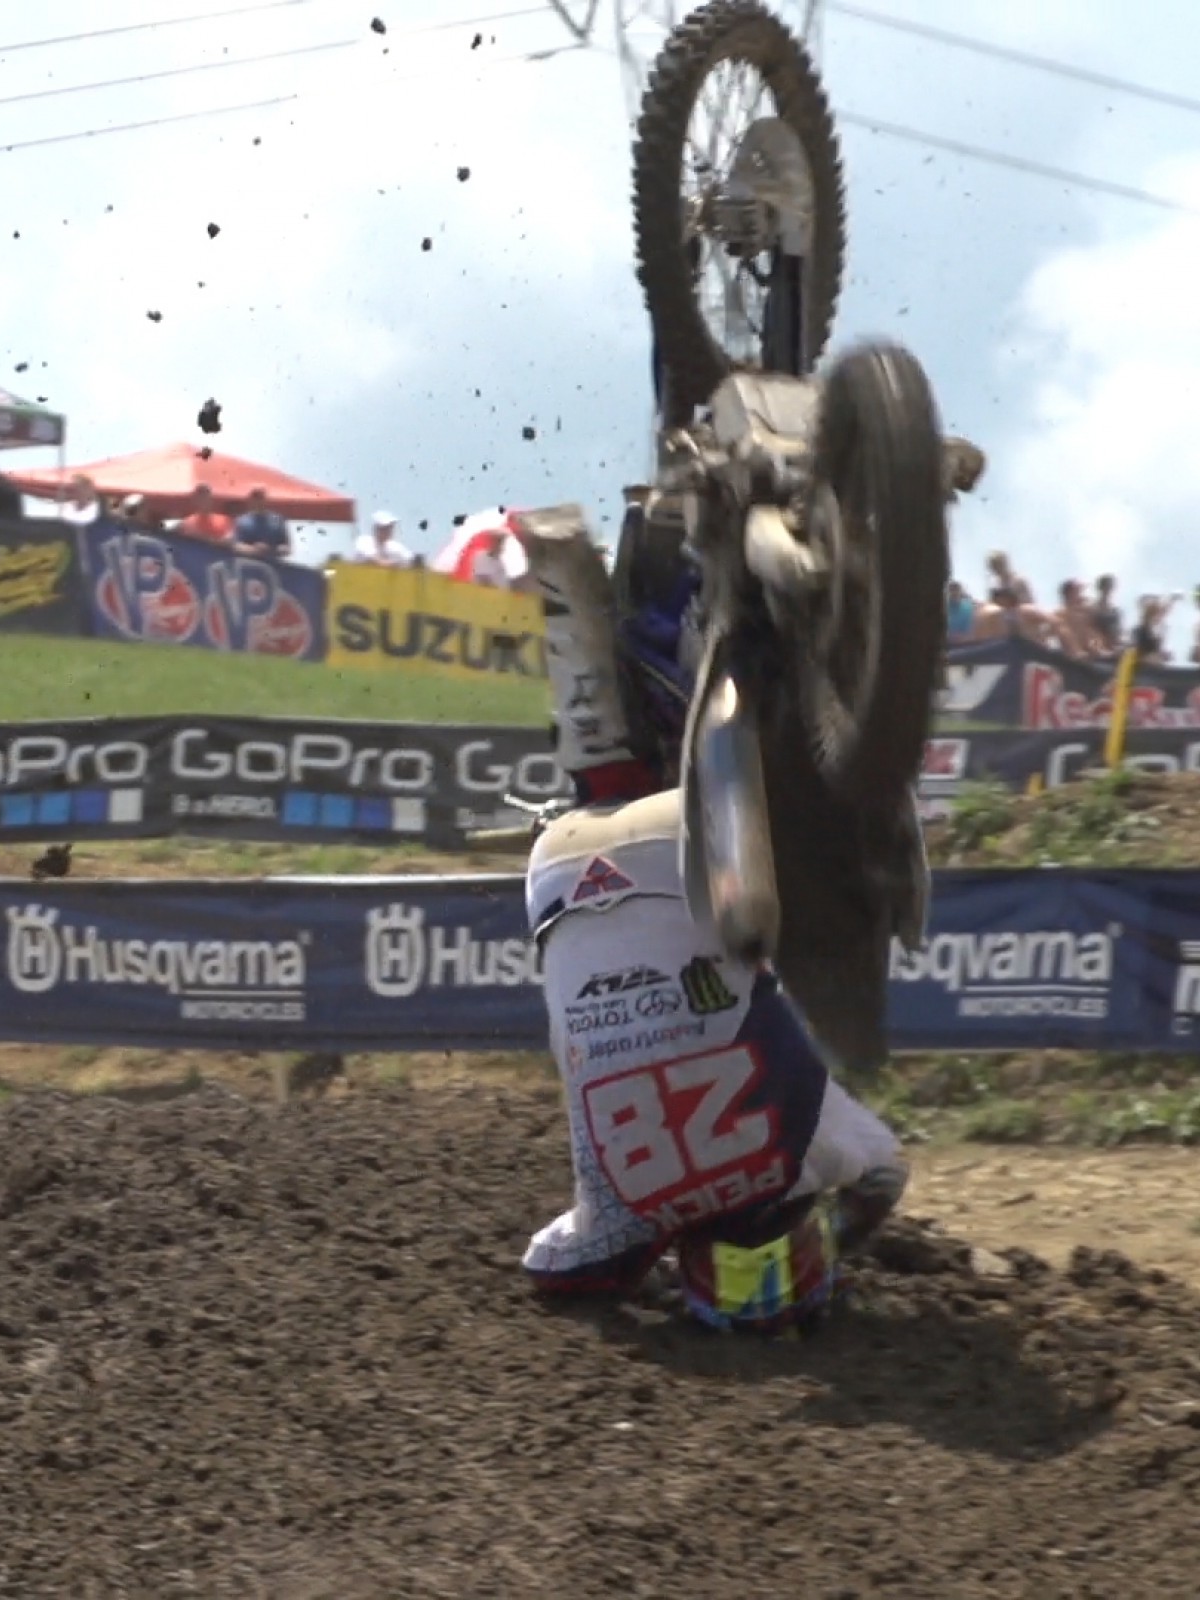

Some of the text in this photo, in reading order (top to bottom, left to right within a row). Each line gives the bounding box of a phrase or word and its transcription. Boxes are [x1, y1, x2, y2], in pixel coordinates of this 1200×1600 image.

[171, 729, 435, 790] GoPro
[62, 925, 306, 995] Husqvarna
[889, 931, 1113, 992] sqvarna
[585, 1047, 772, 1202] 28
